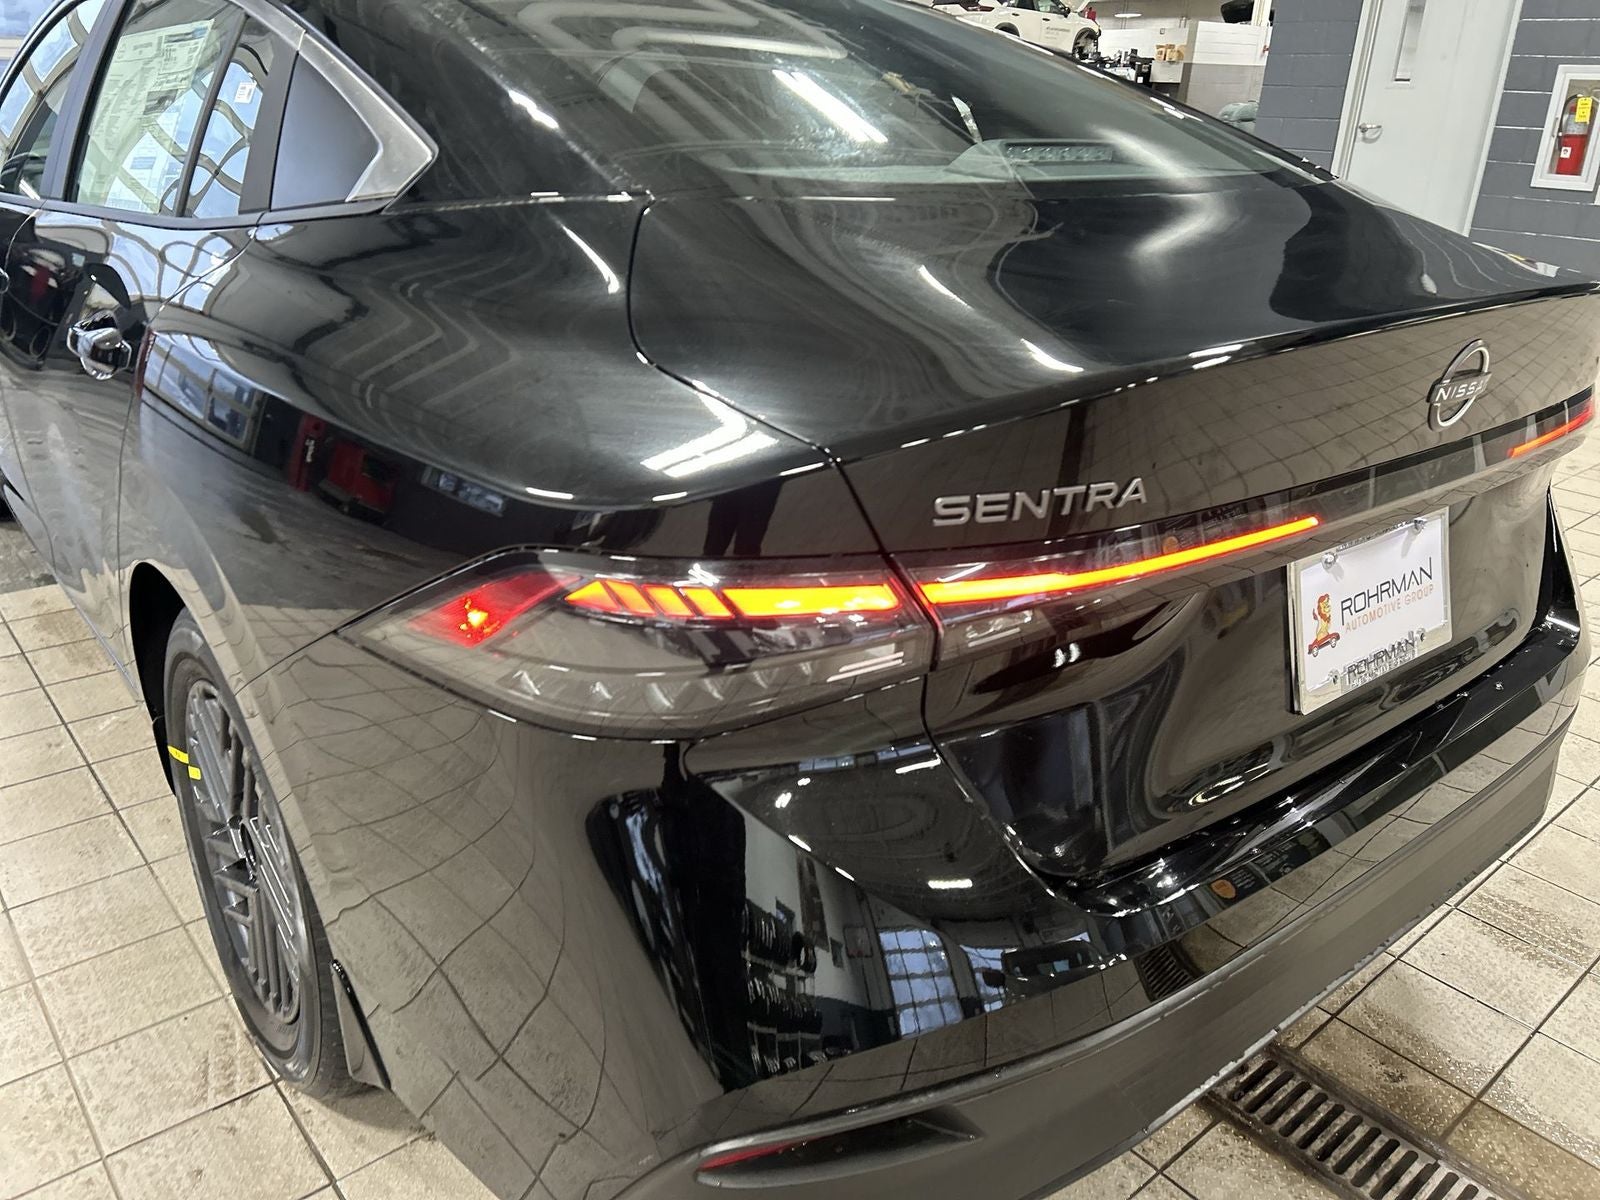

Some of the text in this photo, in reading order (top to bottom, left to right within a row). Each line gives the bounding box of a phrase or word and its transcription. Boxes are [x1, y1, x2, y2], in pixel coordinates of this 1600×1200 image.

[1435, 379, 1485, 402] NISSA
[933, 477, 1147, 527] SENTRA
[1341, 556, 1433, 626] ROHRMAN
[1345, 584, 1434, 633] AUTOMOTIVE GROUP
[1346, 631, 1416, 685] ROHRMAN
